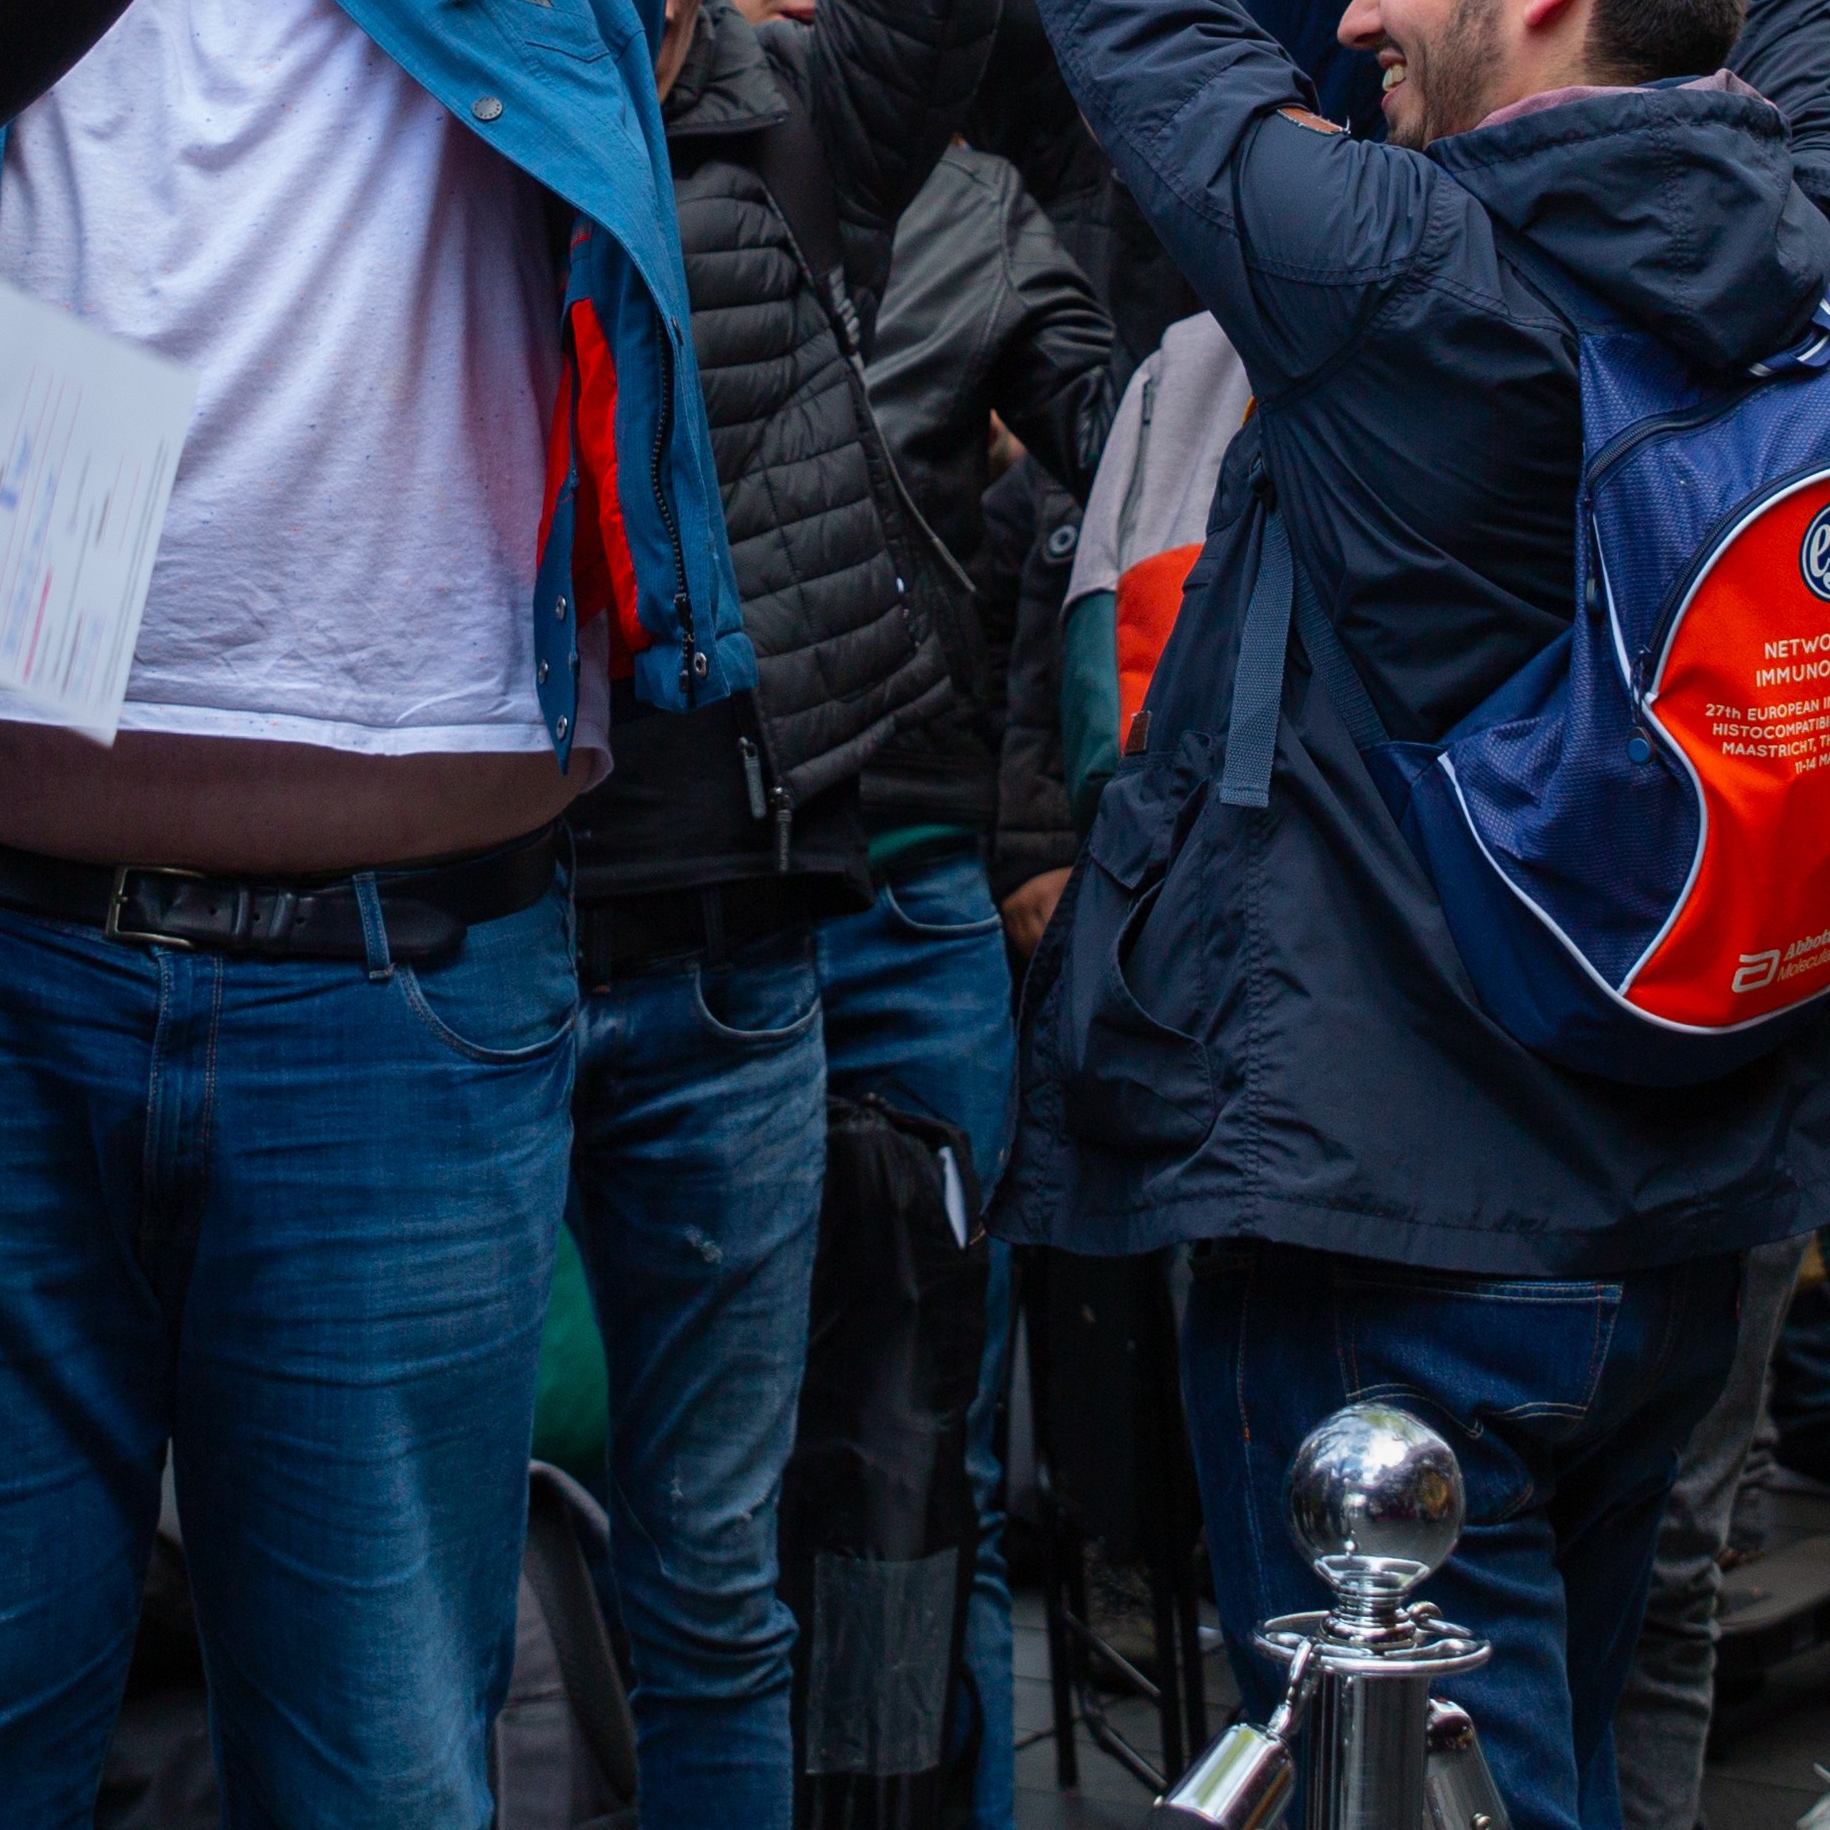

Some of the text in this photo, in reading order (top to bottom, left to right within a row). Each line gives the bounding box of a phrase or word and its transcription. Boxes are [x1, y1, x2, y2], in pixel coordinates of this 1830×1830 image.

[1705, 703, 1741, 719] 27th
[1747, 698, 1819, 721] EUROPEAN
[1722, 737, 1817, 758] MAASTRICHT,
[1795, 756, 1817, 774] 11-14
